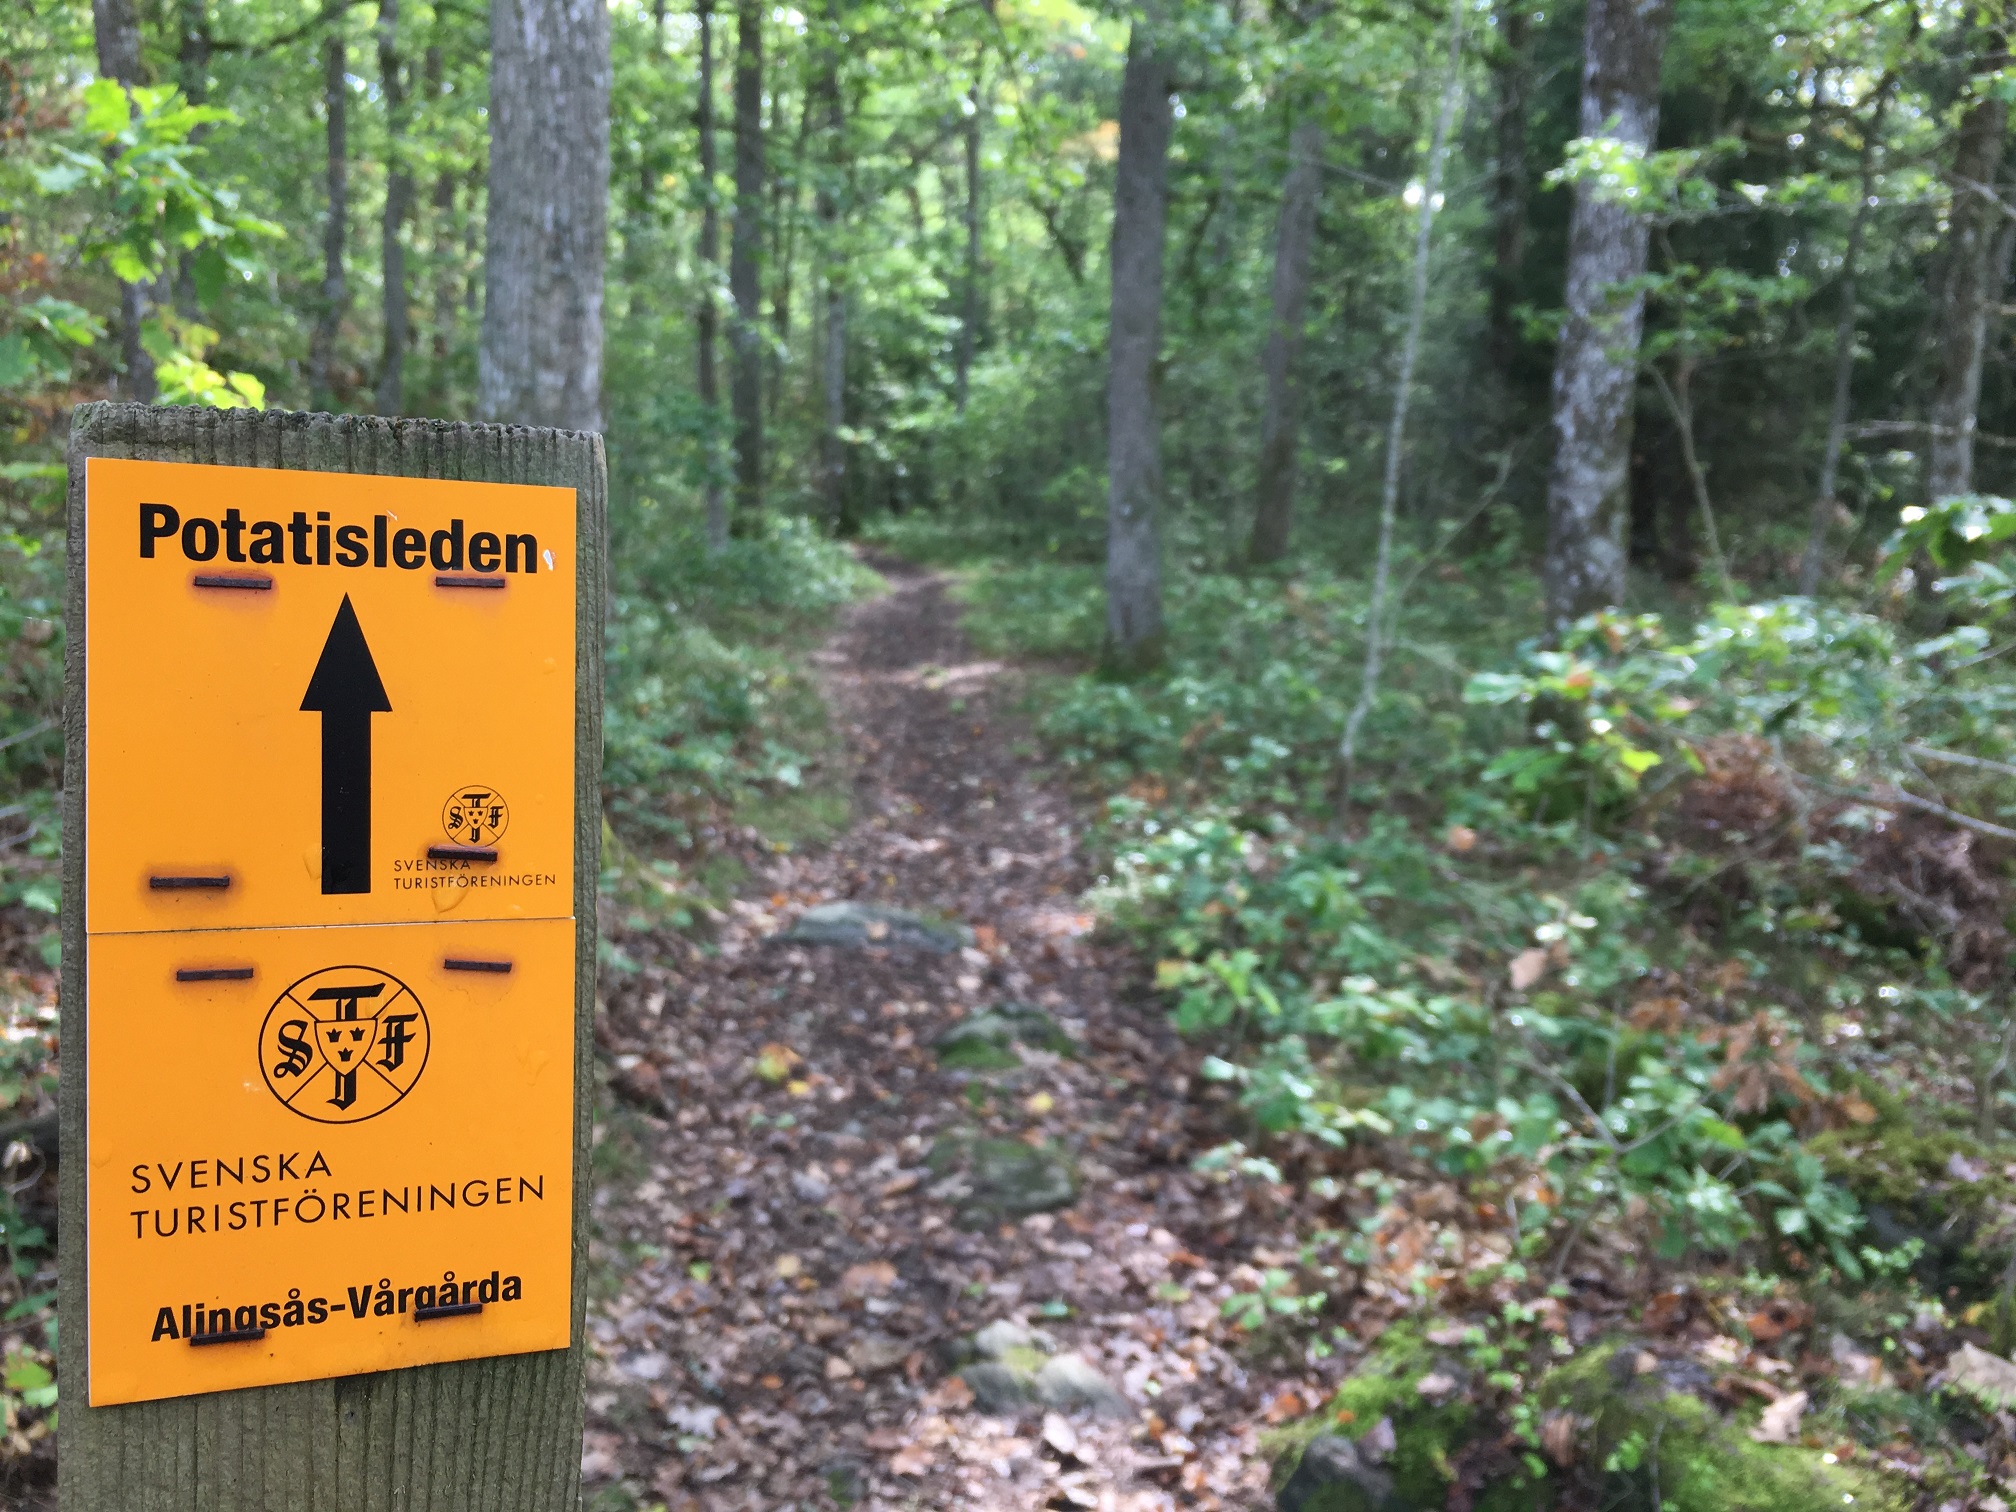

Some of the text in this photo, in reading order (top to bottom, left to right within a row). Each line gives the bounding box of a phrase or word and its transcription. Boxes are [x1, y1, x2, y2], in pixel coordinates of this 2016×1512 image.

[139, 502, 538, 574] Potatisleden
[393, 859, 472, 872] SVENSKA
[393, 872, 556, 890] TURISTFÖRENINGEN
[131, 1150, 333, 1194] SVENSKA
[130, 1175, 545, 1239] TURISTFÖRENINGEN
